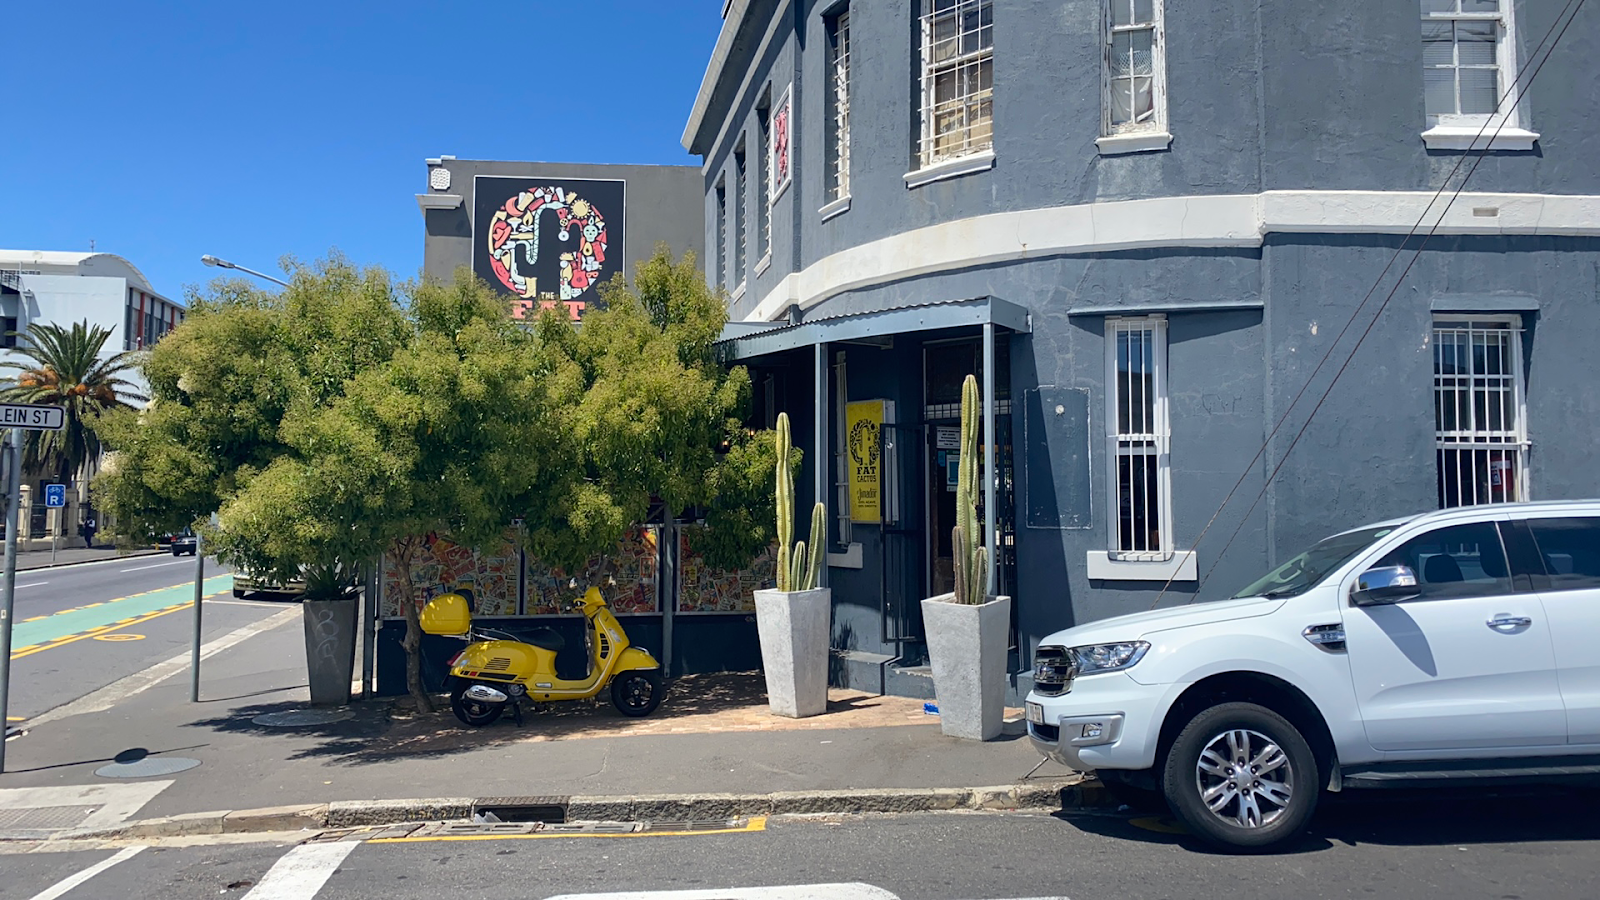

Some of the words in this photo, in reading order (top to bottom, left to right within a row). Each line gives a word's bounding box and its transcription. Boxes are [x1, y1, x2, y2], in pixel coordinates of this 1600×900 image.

[541, 292, 555, 300] THE
[33, 410, 51, 424] ST
[857, 466, 877, 475] FAT
[857, 475, 877, 483] CACTUS
[50, 495, 59, 505] R
